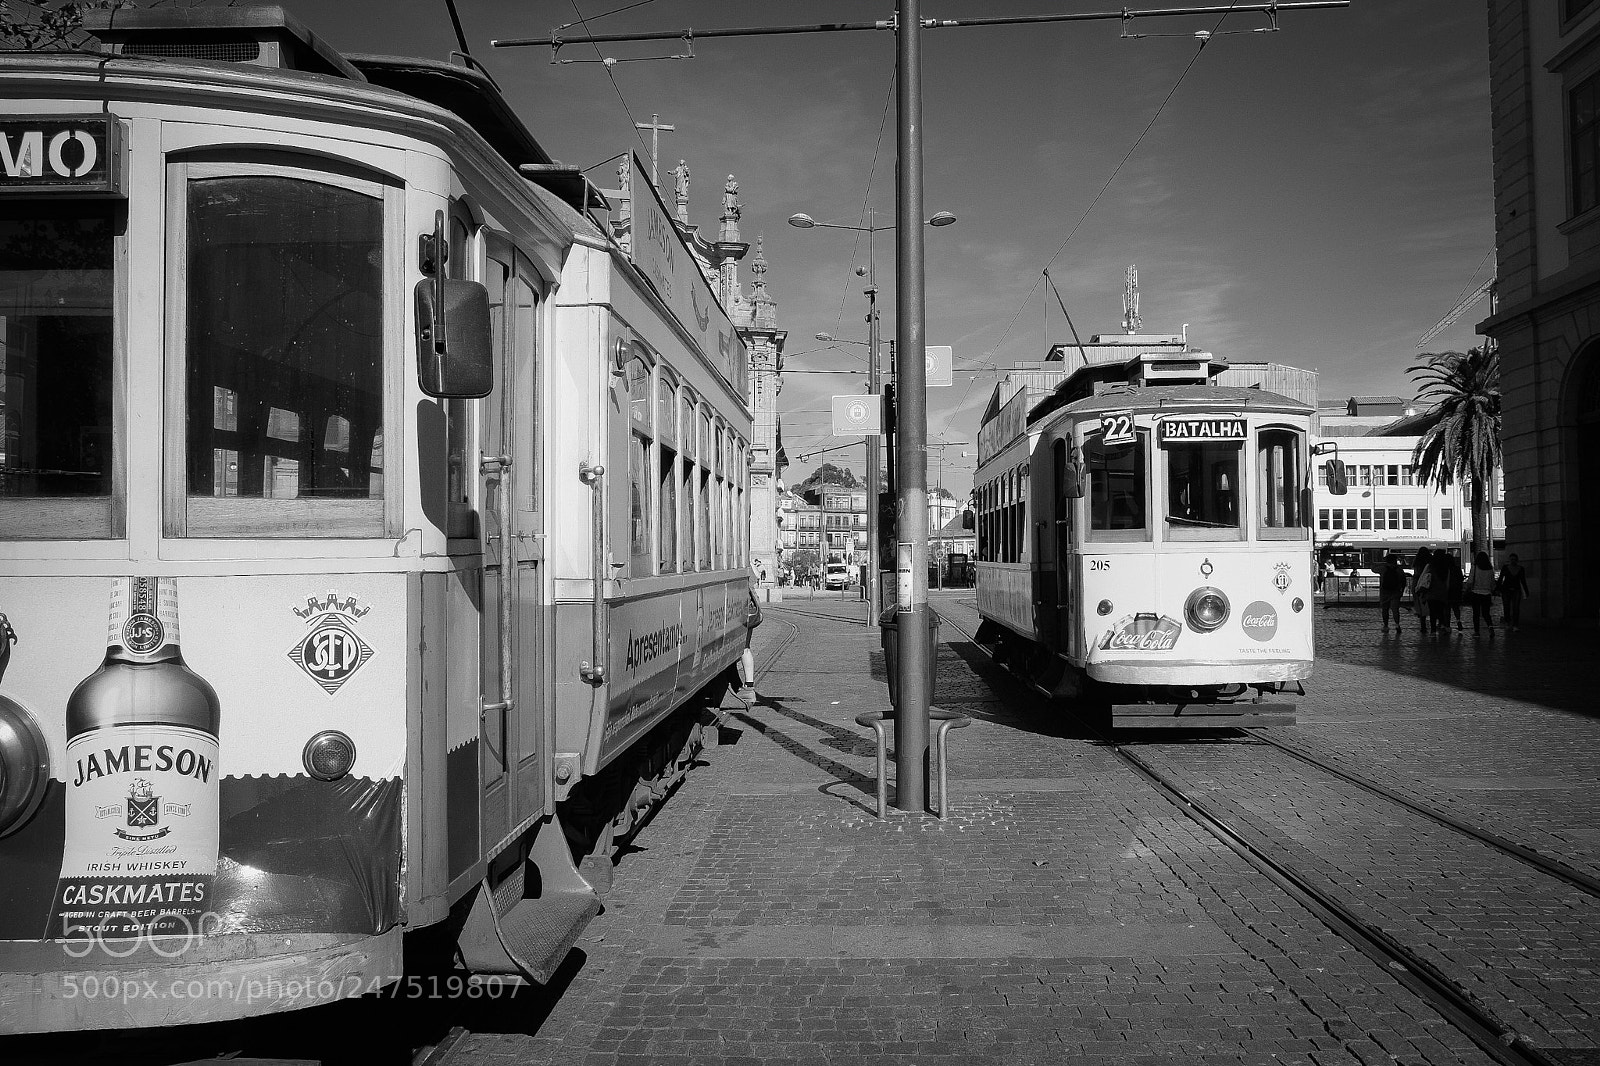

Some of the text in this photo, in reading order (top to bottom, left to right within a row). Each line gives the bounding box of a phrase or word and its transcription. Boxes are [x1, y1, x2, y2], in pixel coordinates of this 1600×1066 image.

[1103, 416, 1133, 440] 22
[1164, 421, 1245, 437] BATALHA
[1090, 560, 1111, 571] 205
[73, 745, 212, 788] JAMESON
[87, 860, 188, 872] IRISH WHISKEY
[62, 882, 205, 905] CASKMATES
[97, 910, 129, 918] CRAFT
[130, 909, 157, 918] BEER
[159, 908, 196, 916] BARRELS
[78, 922, 176, 932] STOUT EDITION
